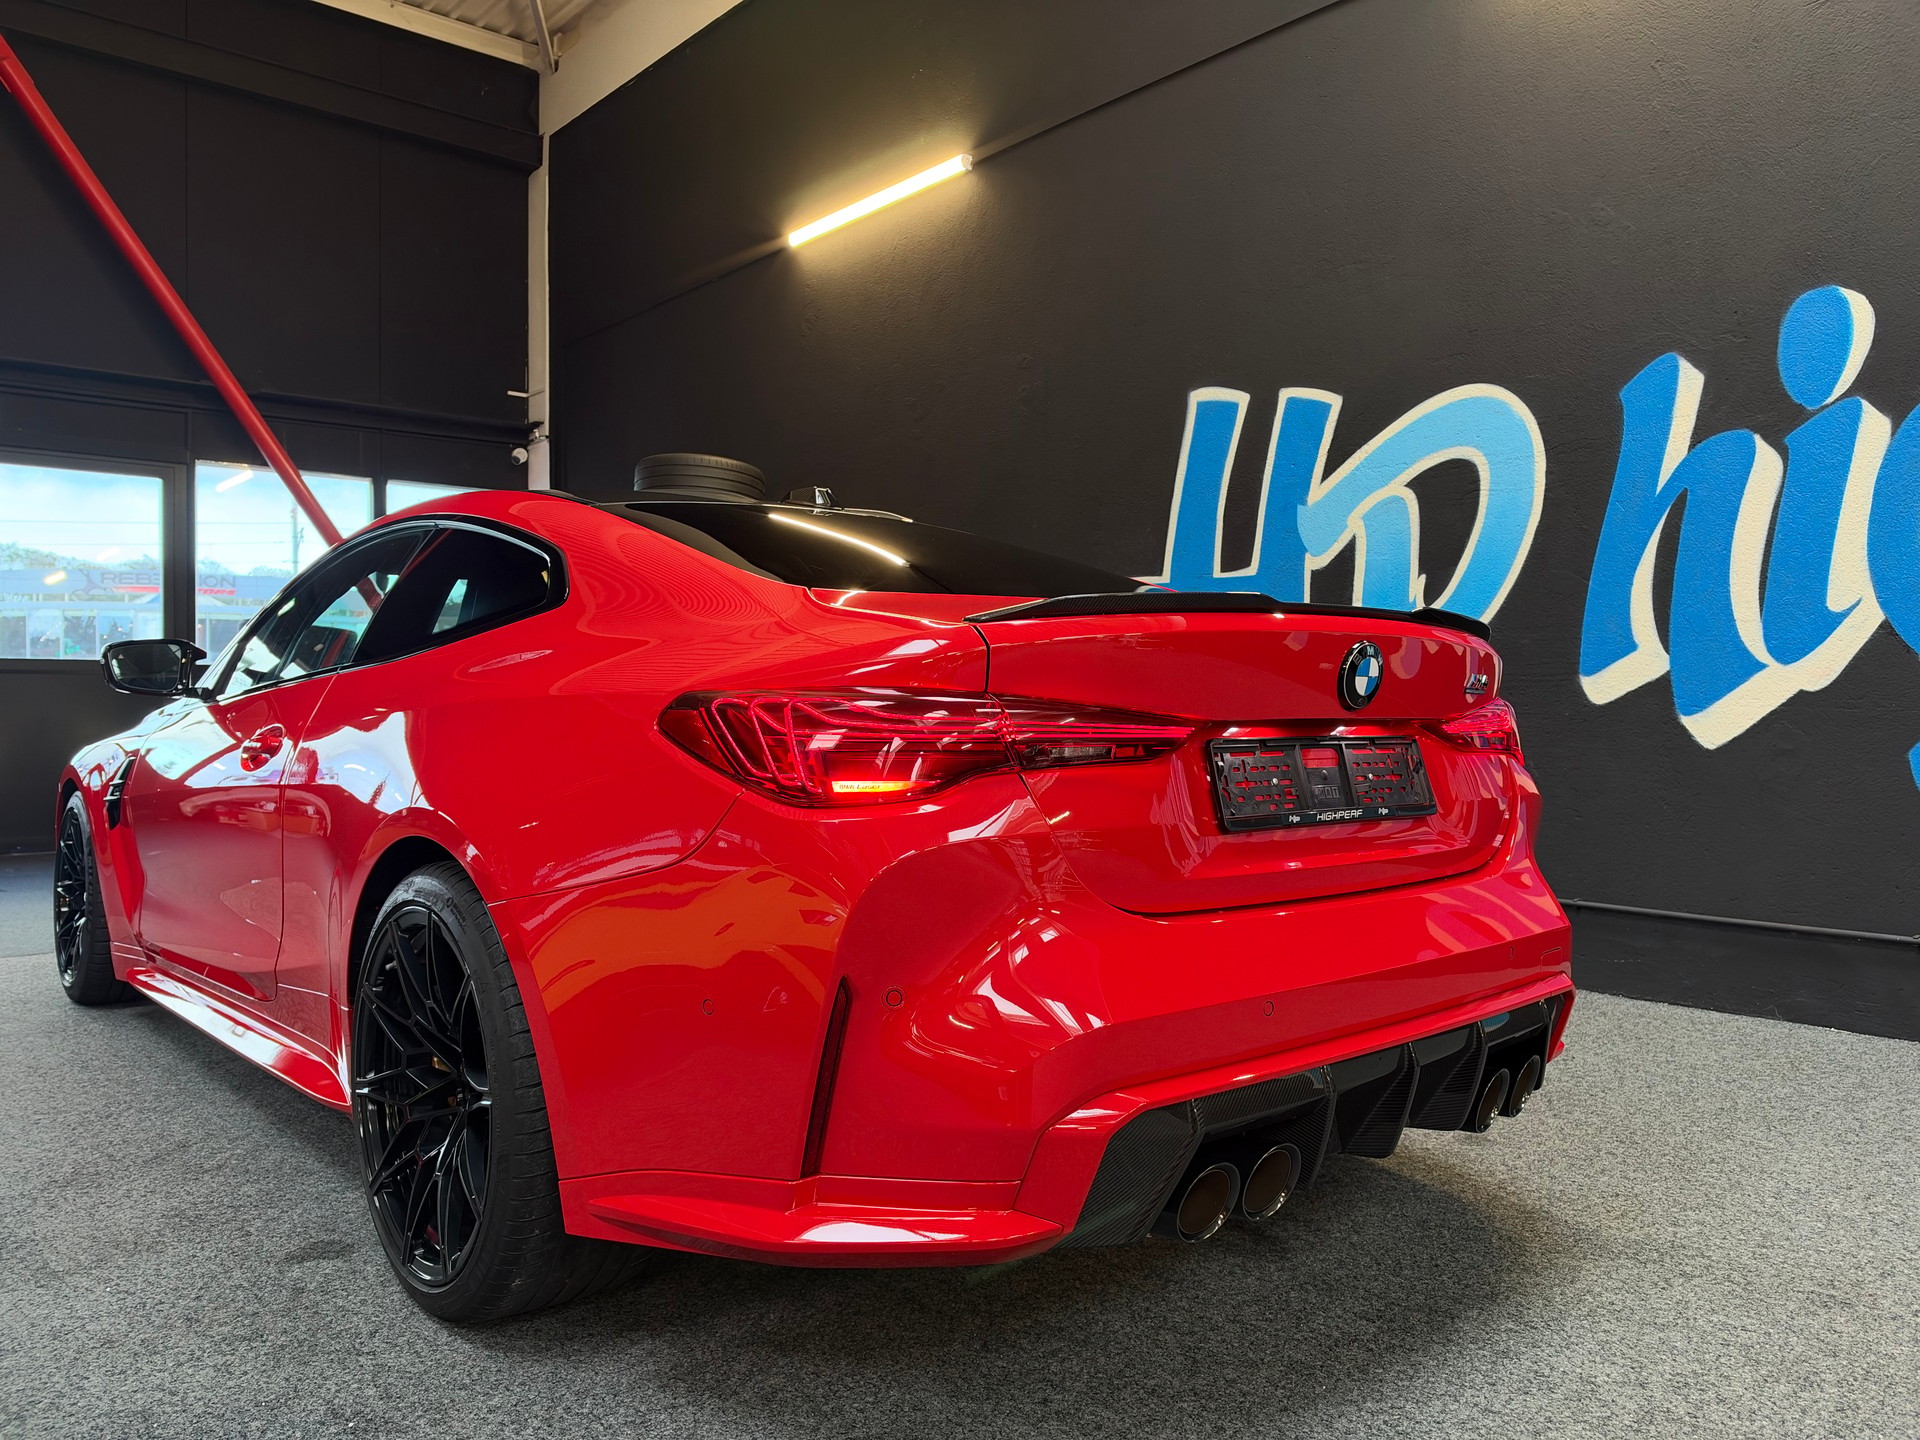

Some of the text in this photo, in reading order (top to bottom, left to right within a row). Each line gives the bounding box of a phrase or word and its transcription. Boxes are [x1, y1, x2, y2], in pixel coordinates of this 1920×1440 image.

[1580, 285, 1920, 790] hi
[1353, 645, 1383, 666] BMW
[1316, 809, 1363, 821] HIGHPERF
